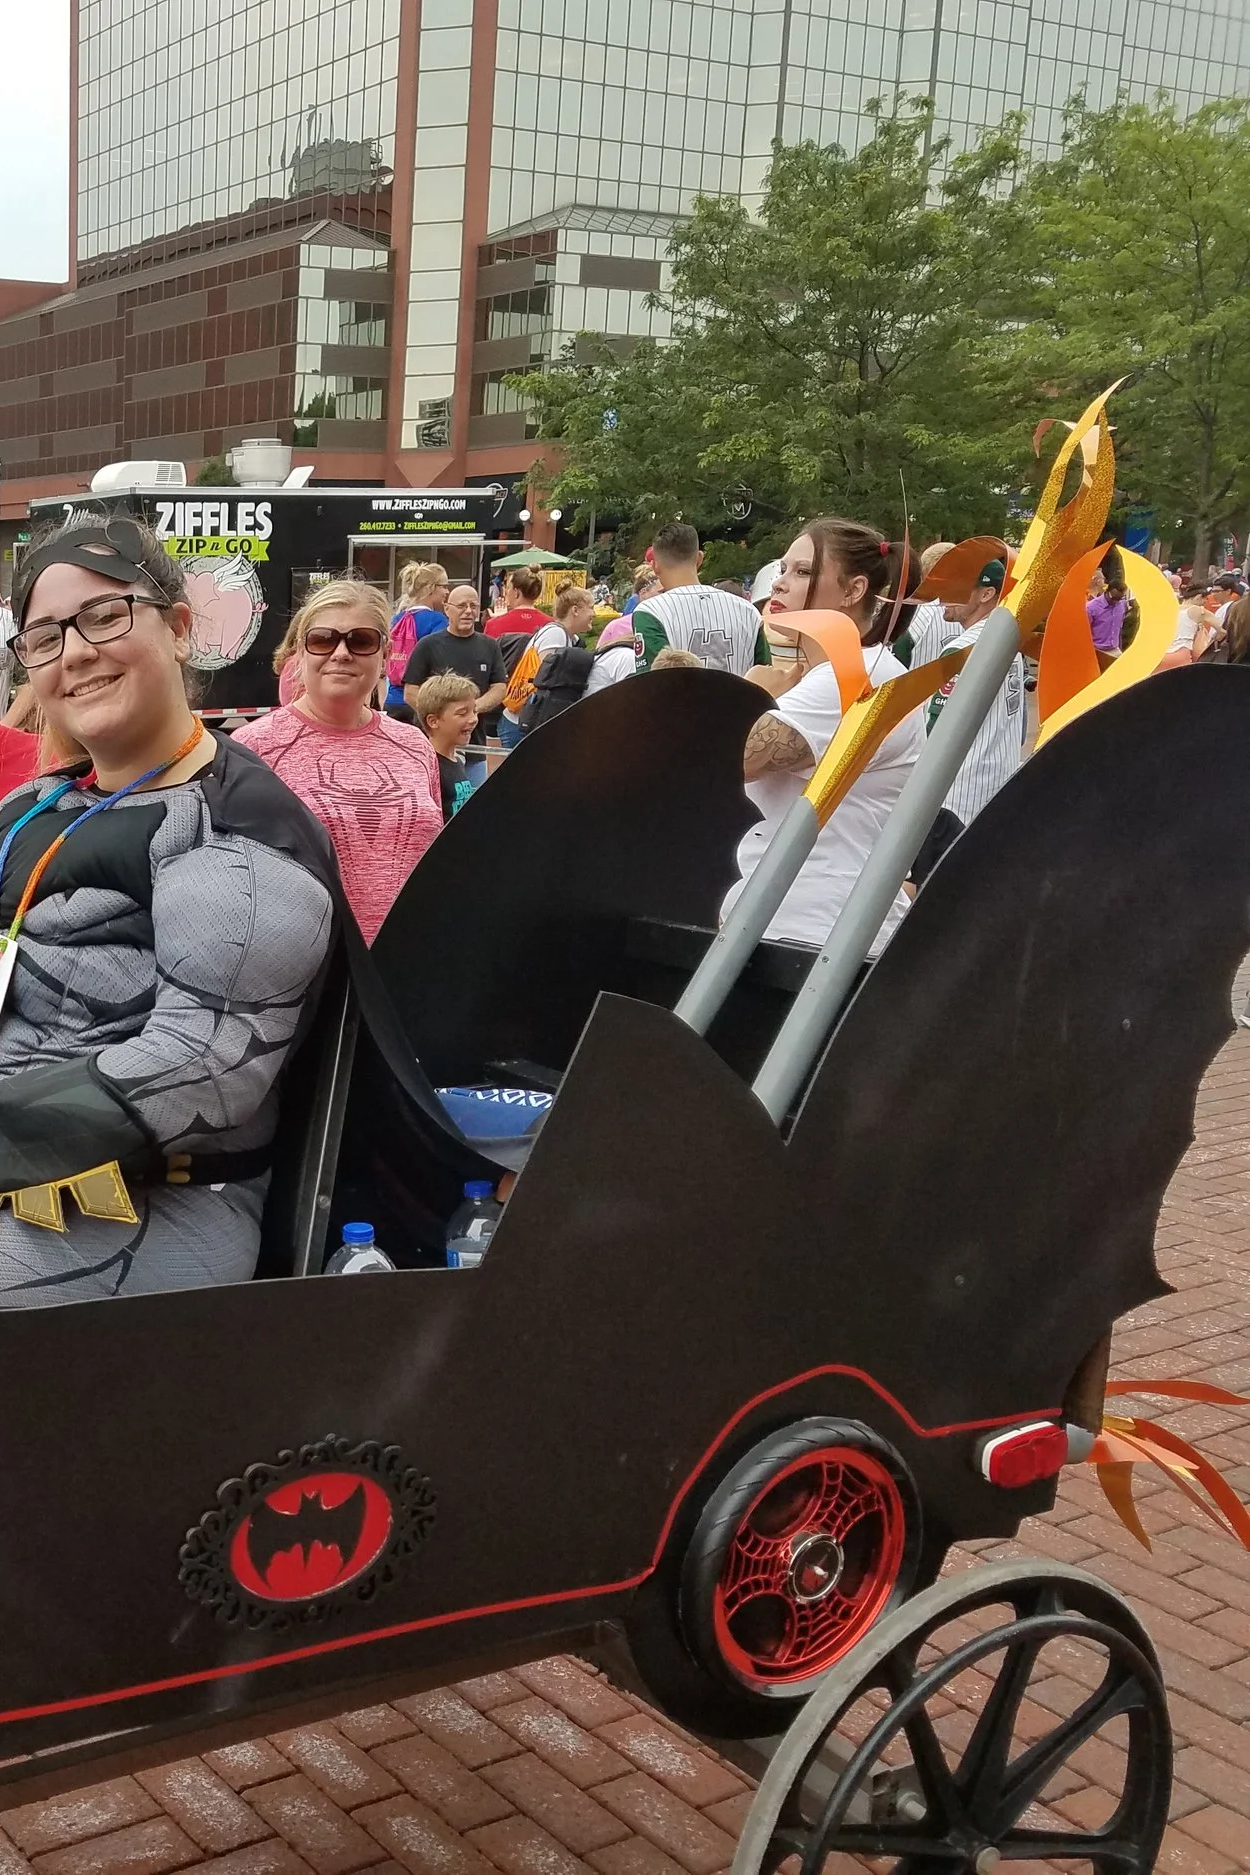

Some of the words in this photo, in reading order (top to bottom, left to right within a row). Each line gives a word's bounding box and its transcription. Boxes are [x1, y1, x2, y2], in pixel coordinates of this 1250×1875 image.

[155, 501, 273, 541] ZIFFLES
[175, 538, 207, 554] ZIP
[210, 541, 222, 551] n
[225, 538, 253, 554] GO
